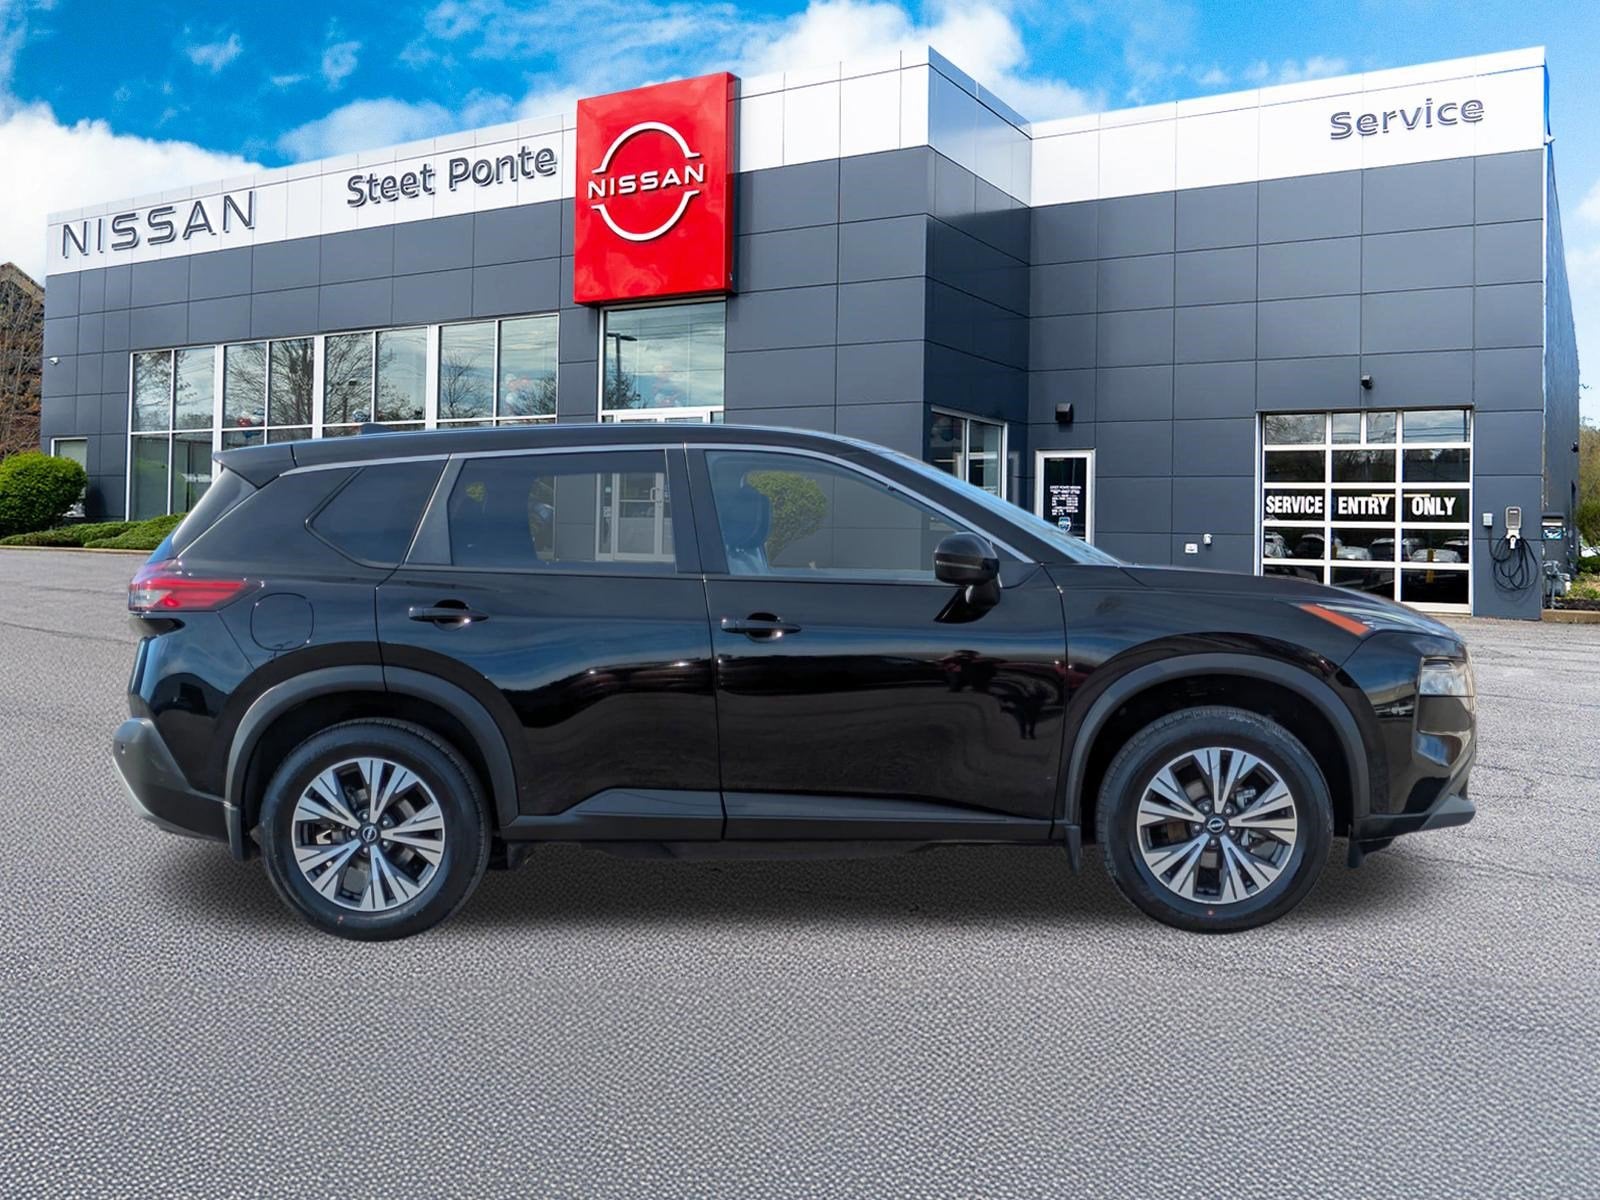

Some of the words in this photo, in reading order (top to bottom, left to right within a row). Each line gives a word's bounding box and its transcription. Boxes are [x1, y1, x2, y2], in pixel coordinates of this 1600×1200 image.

[1330, 98, 1485, 140] Service
[347, 163, 435, 207] Steet
[448, 145, 558, 192] Ponte
[587, 163, 704, 200] NISSAN
[62, 190, 256, 259] NISSAN
[1265, 495, 1323, 515] SERVICE
[1338, 496, 1390, 516] ENTRY
[1411, 496, 1456, 516] ONLY
